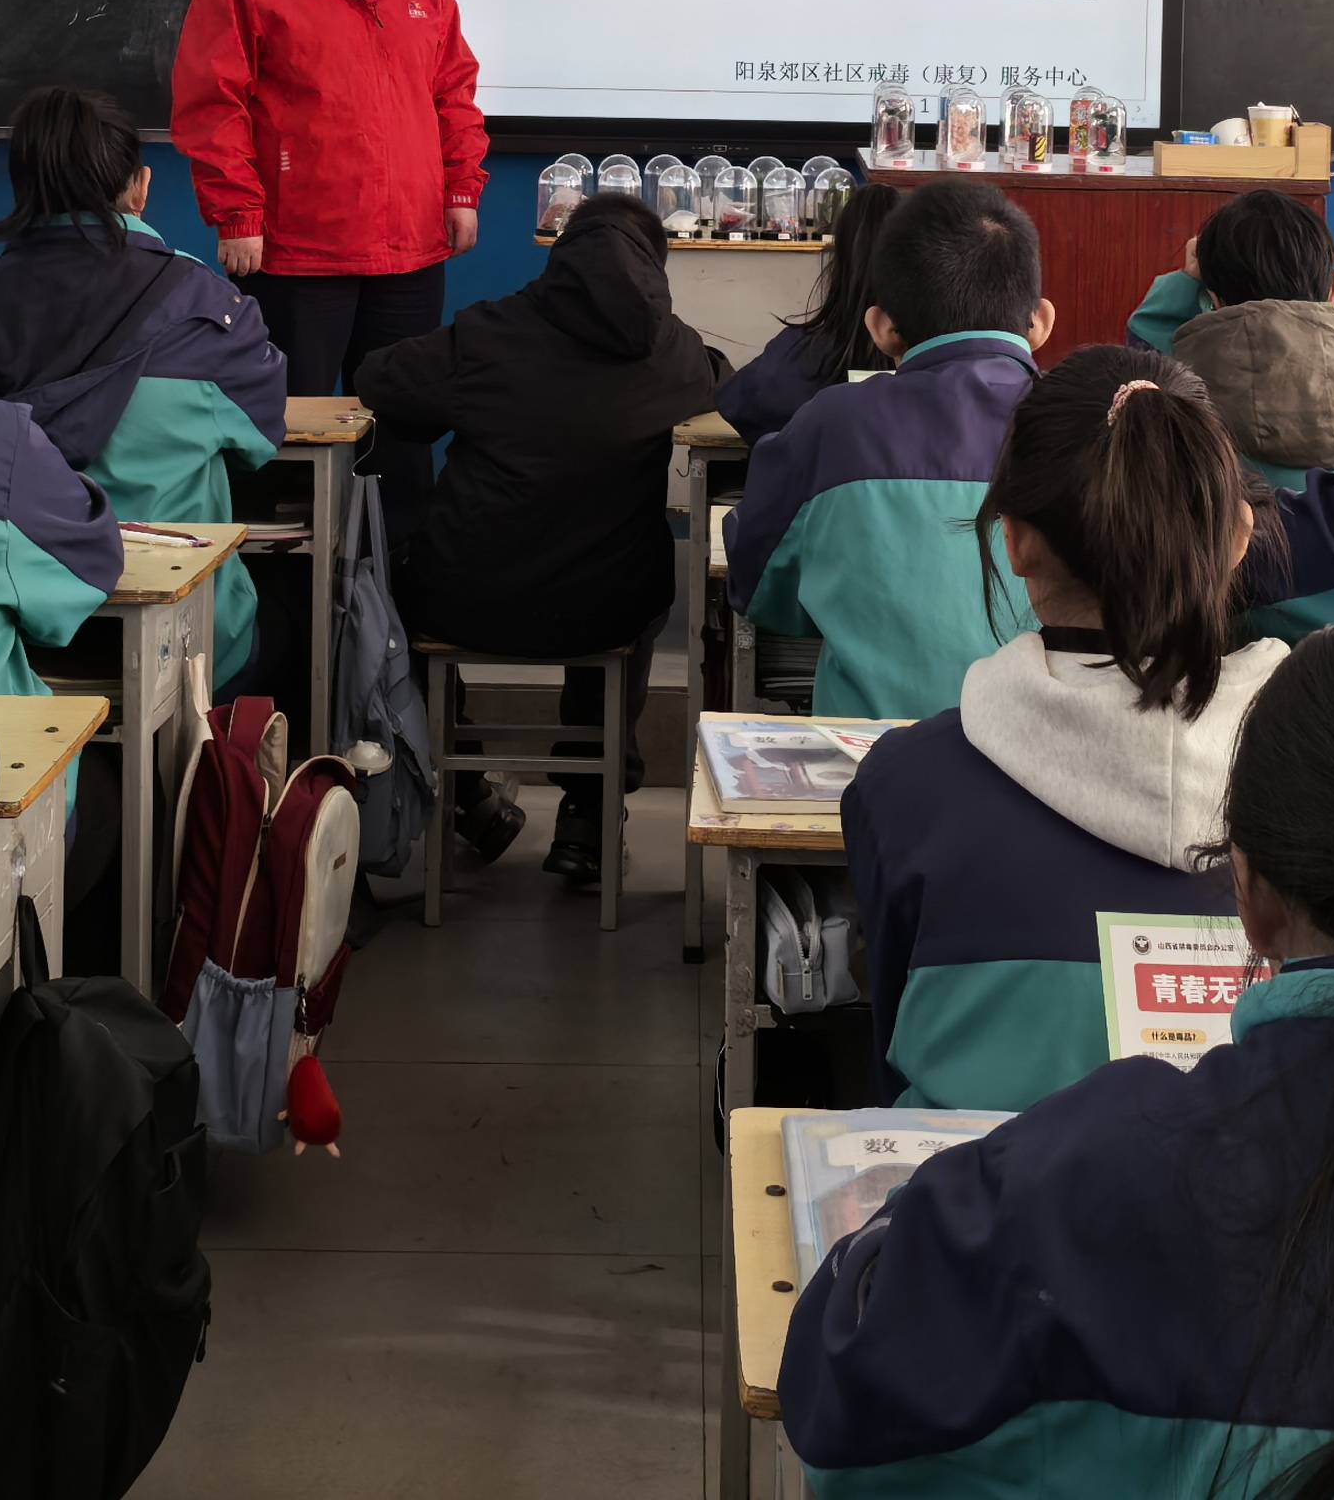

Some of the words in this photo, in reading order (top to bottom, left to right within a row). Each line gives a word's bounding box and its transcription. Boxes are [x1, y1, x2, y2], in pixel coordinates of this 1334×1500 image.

[735, 61, 1087, 87] 阳泉郊区社区戒毒（康复）服务中心
[920, 98, 930, 114] 1
[1151, 973, 1264, 1004] 青春无
